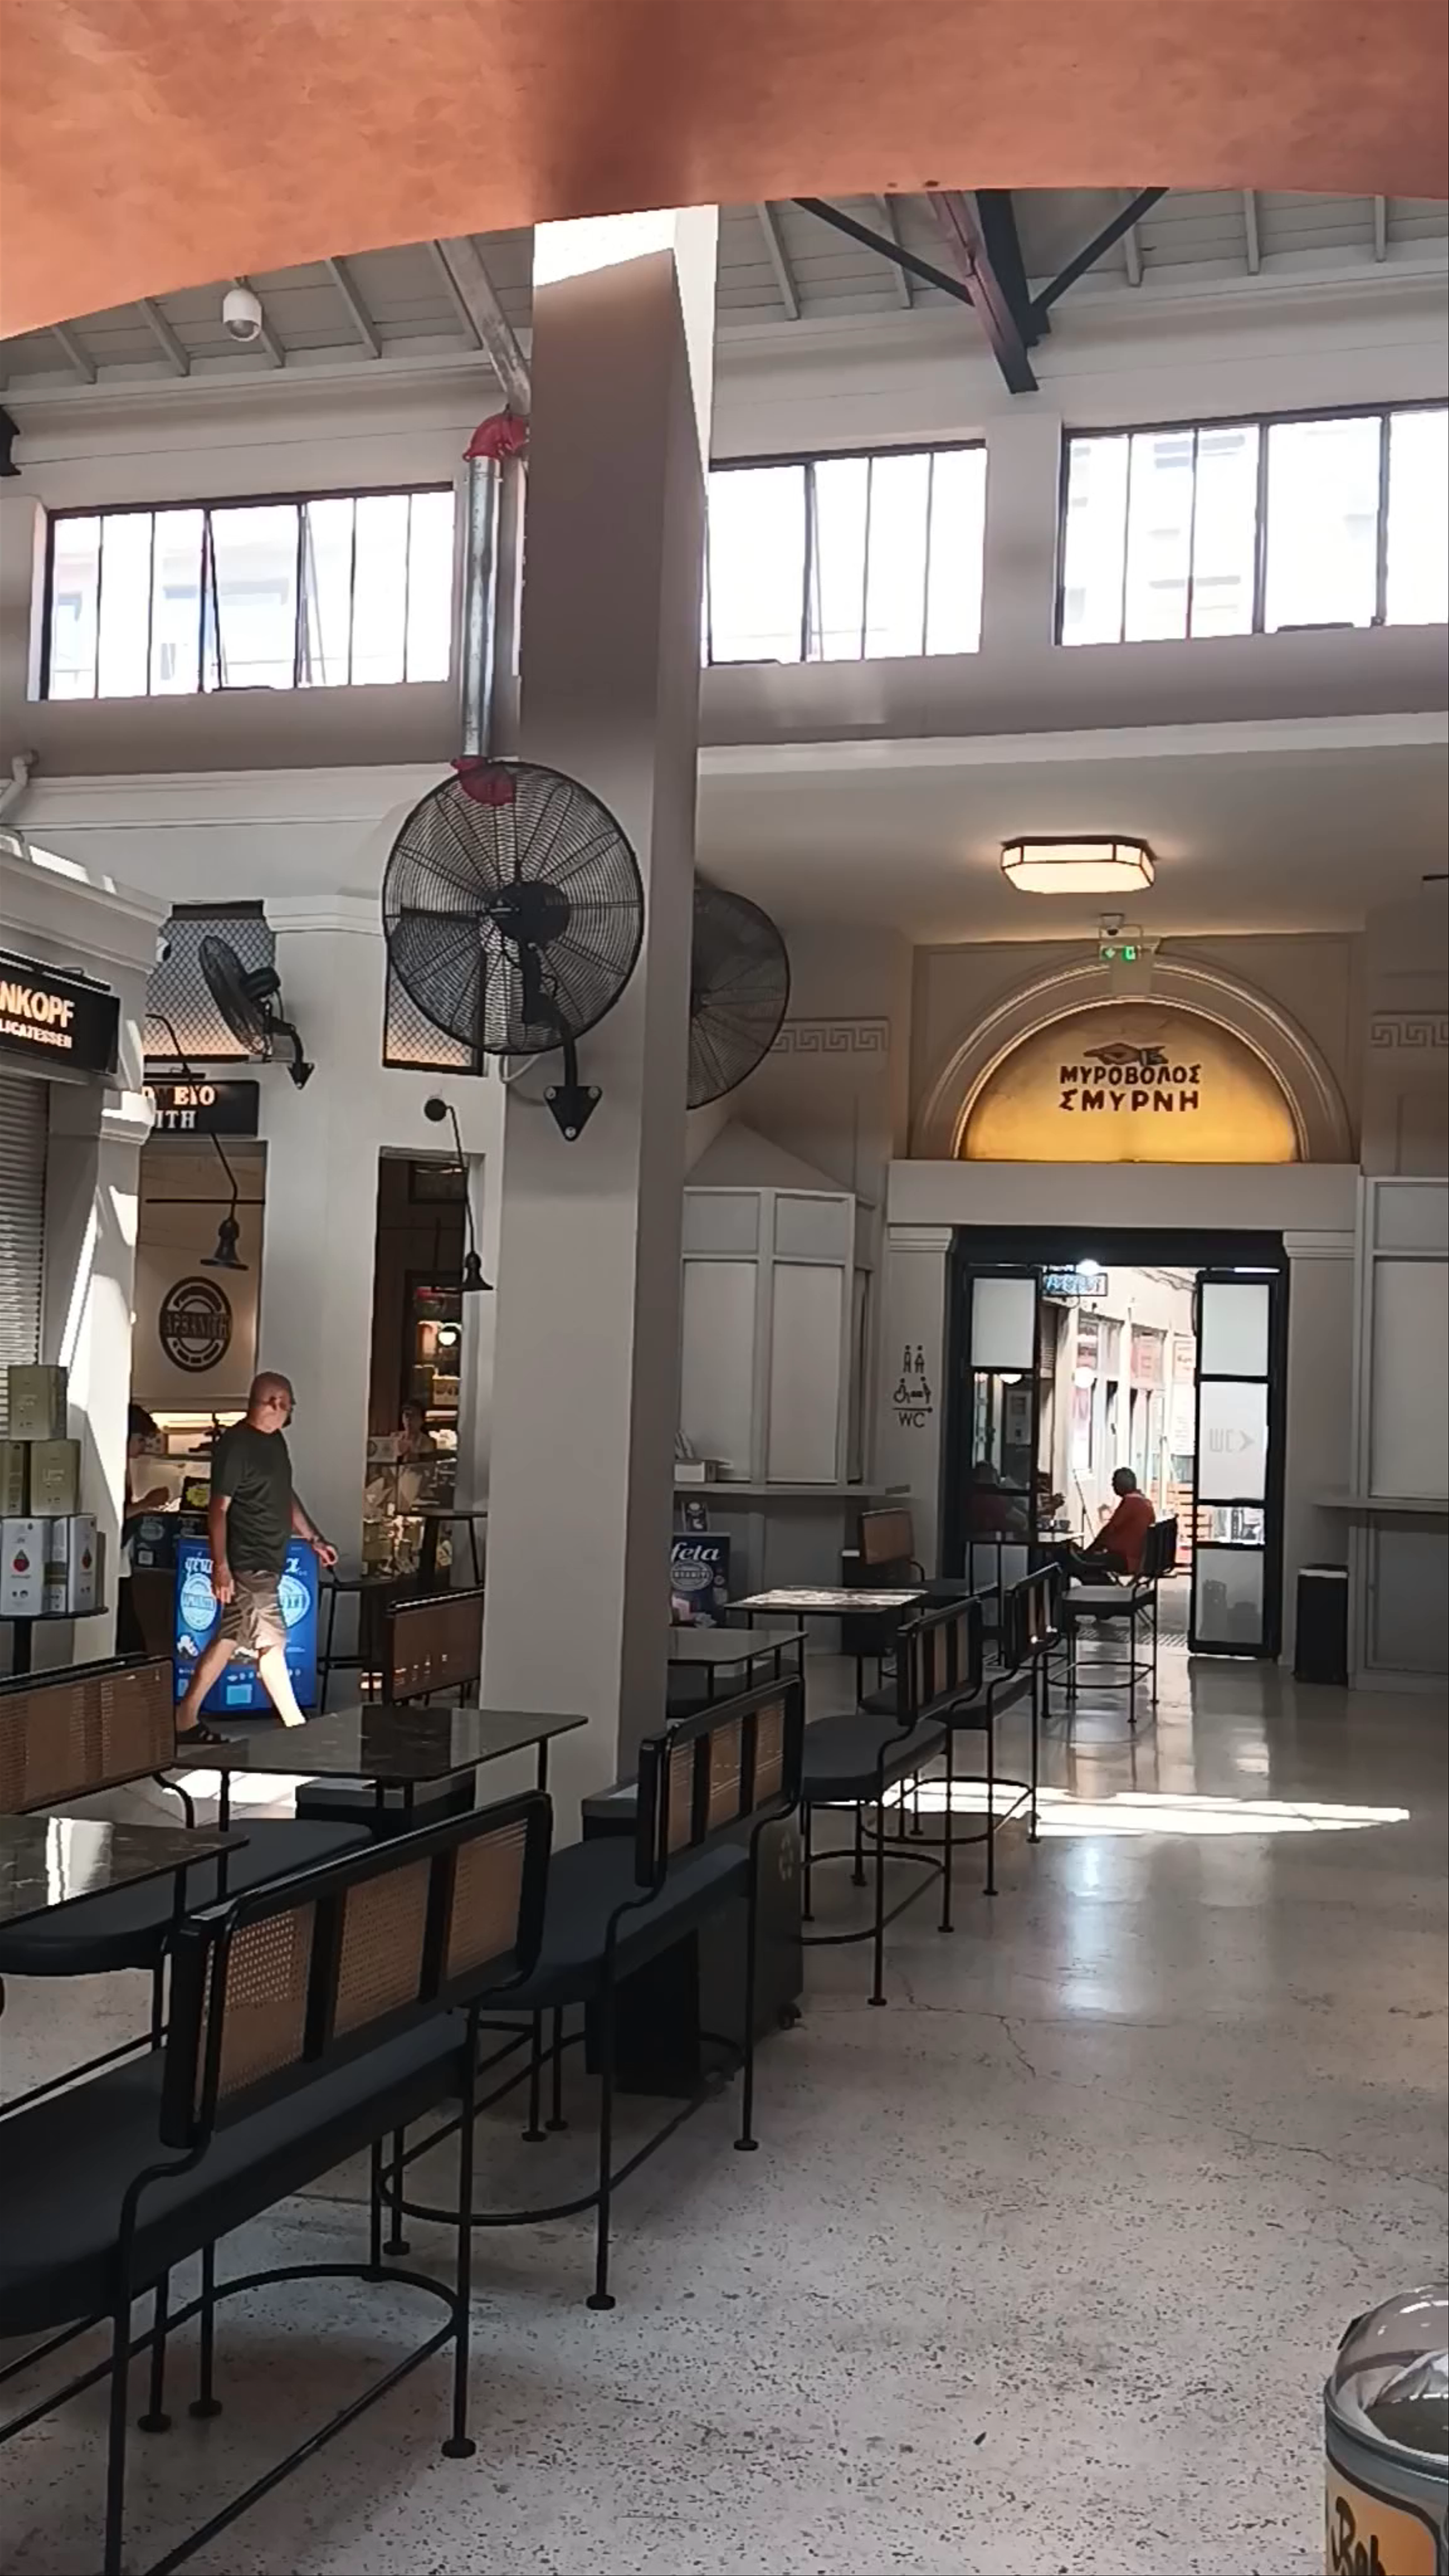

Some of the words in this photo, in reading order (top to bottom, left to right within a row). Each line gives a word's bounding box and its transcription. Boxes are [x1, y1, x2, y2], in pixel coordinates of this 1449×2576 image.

[1060, 1064, 1201, 1084] ΜΥΡΟΒΟΛΟΣ
[1059, 1089, 1198, 1112] ΣΜΥΡΝΗ
[898, 1411, 925, 1429] WC
